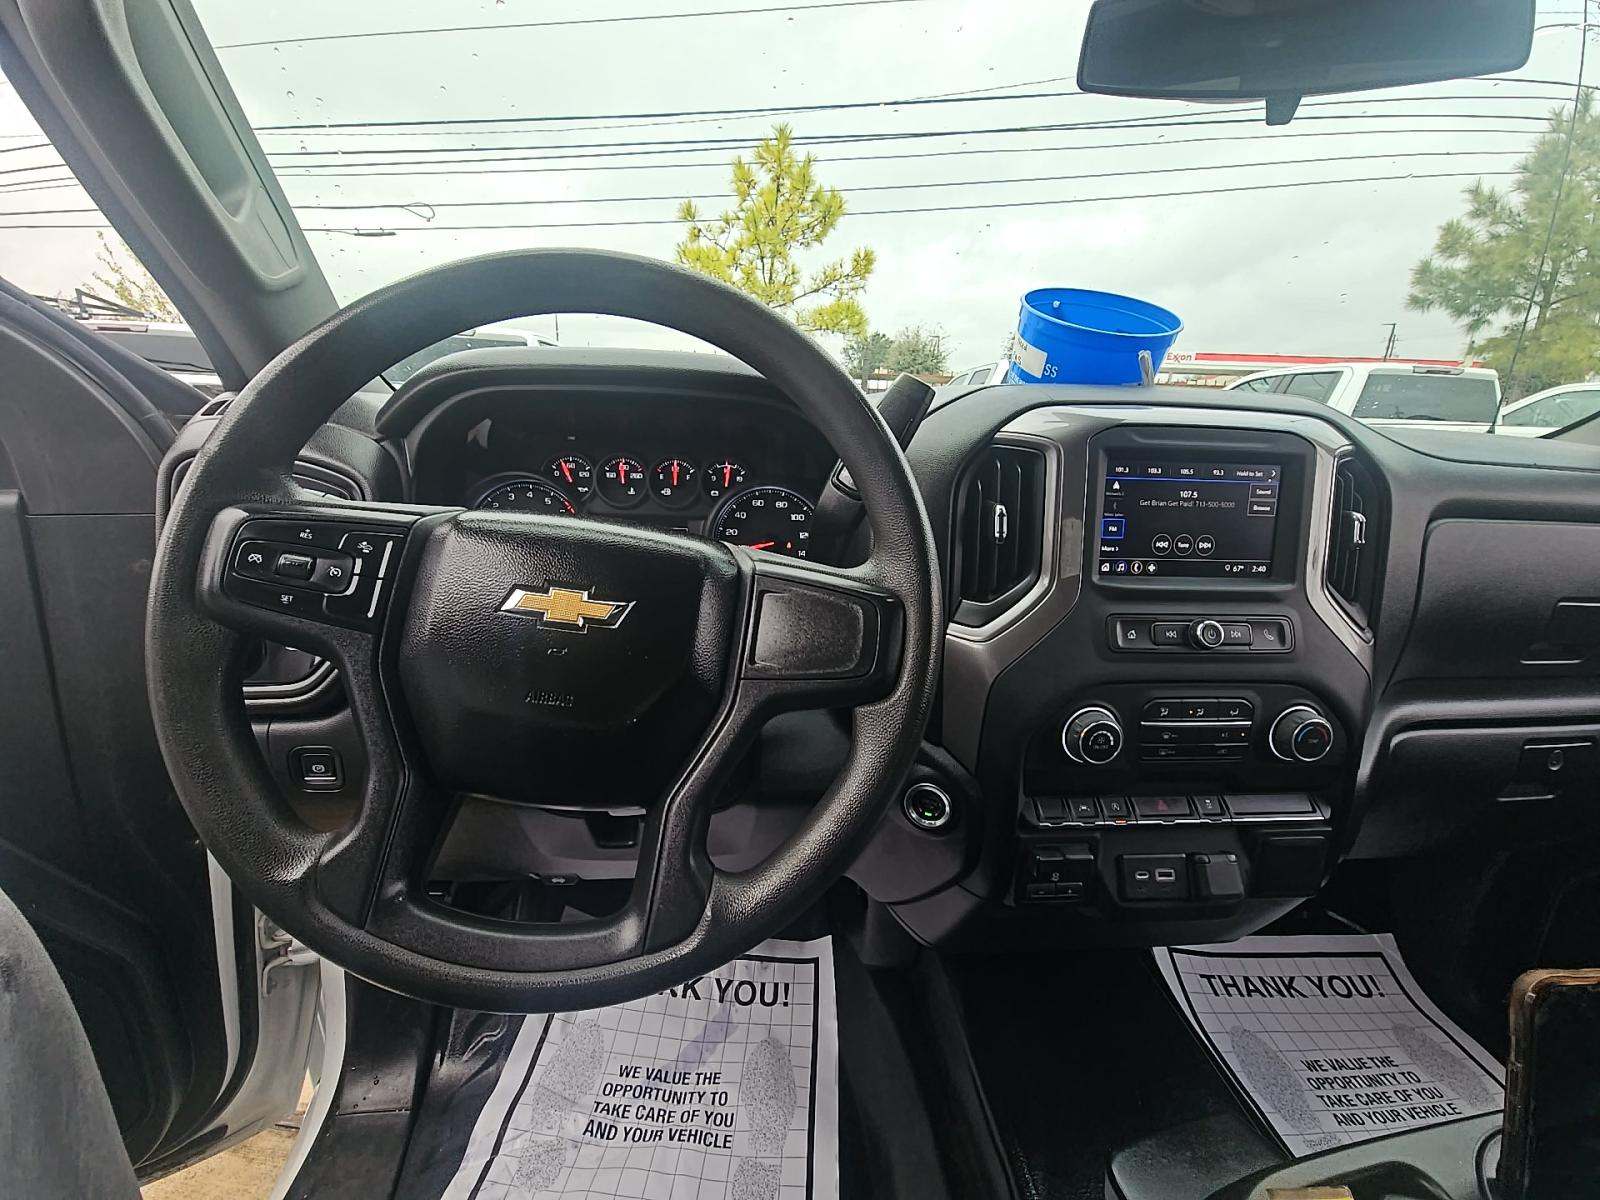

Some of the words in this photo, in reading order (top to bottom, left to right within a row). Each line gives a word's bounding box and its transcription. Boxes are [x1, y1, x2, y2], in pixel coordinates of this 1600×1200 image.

[1166, 352, 1192, 363] Exxon
[508, 493, 515, 501] 3
[1179, 490, 1198, 499] 107.5
[544, 497, 552, 505] 5
[752, 499, 765, 507] 60
[1139, 499, 1151, 507] Get
[1151, 499, 1167, 507] Brian
[1167, 500, 1179, 508] Get
[734, 511, 747, 519] 40
[790, 513, 805, 521] 100
[299, 532, 313, 540] RES
[725, 528, 738, 536] 20
[280, 594, 294, 603] SET
[1199, 973, 1309, 999] THANK
[1305, 974, 1386, 999] YOU!
[715, 977, 790, 1008] YOU!
[1300, 1059, 1329, 1073] WE
[1323, 1056, 1373, 1072] VALUE
[1367, 1055, 1400, 1068] THE
[618, 1064, 642, 1079] WE
[645, 1067, 692, 1086] VALUE
[694, 1072, 722, 1086] THE
[1306, 1072, 1401, 1091] OPPORTUNITY
[1398, 1071, 1422, 1084] TO
[602, 1082, 706, 1106] OPPORTUNITY
[709, 1091, 729, 1107] TO
[1316, 1093, 1358, 1108] TAKE
[1354, 1090, 1397, 1106] CARE
[1394, 1088, 1414, 1102] OF
[1412, 1086, 1445, 1101] YOU
[592, 1100, 633, 1120] TAKE
[635, 1104, 677, 1124] CARE
[680, 1109, 701, 1124] OF
[704, 1110, 735, 1129] YOU
[1332, 1111, 1367, 1127] AND
[1363, 1108, 1407, 1125] YOUR
[1402, 1102, 1463, 1121] VEHICLE
[582, 1119, 619, 1141] AND
[622, 1126, 664, 1143] YOUR
[668, 1127, 734, 1150] VEHICLE
